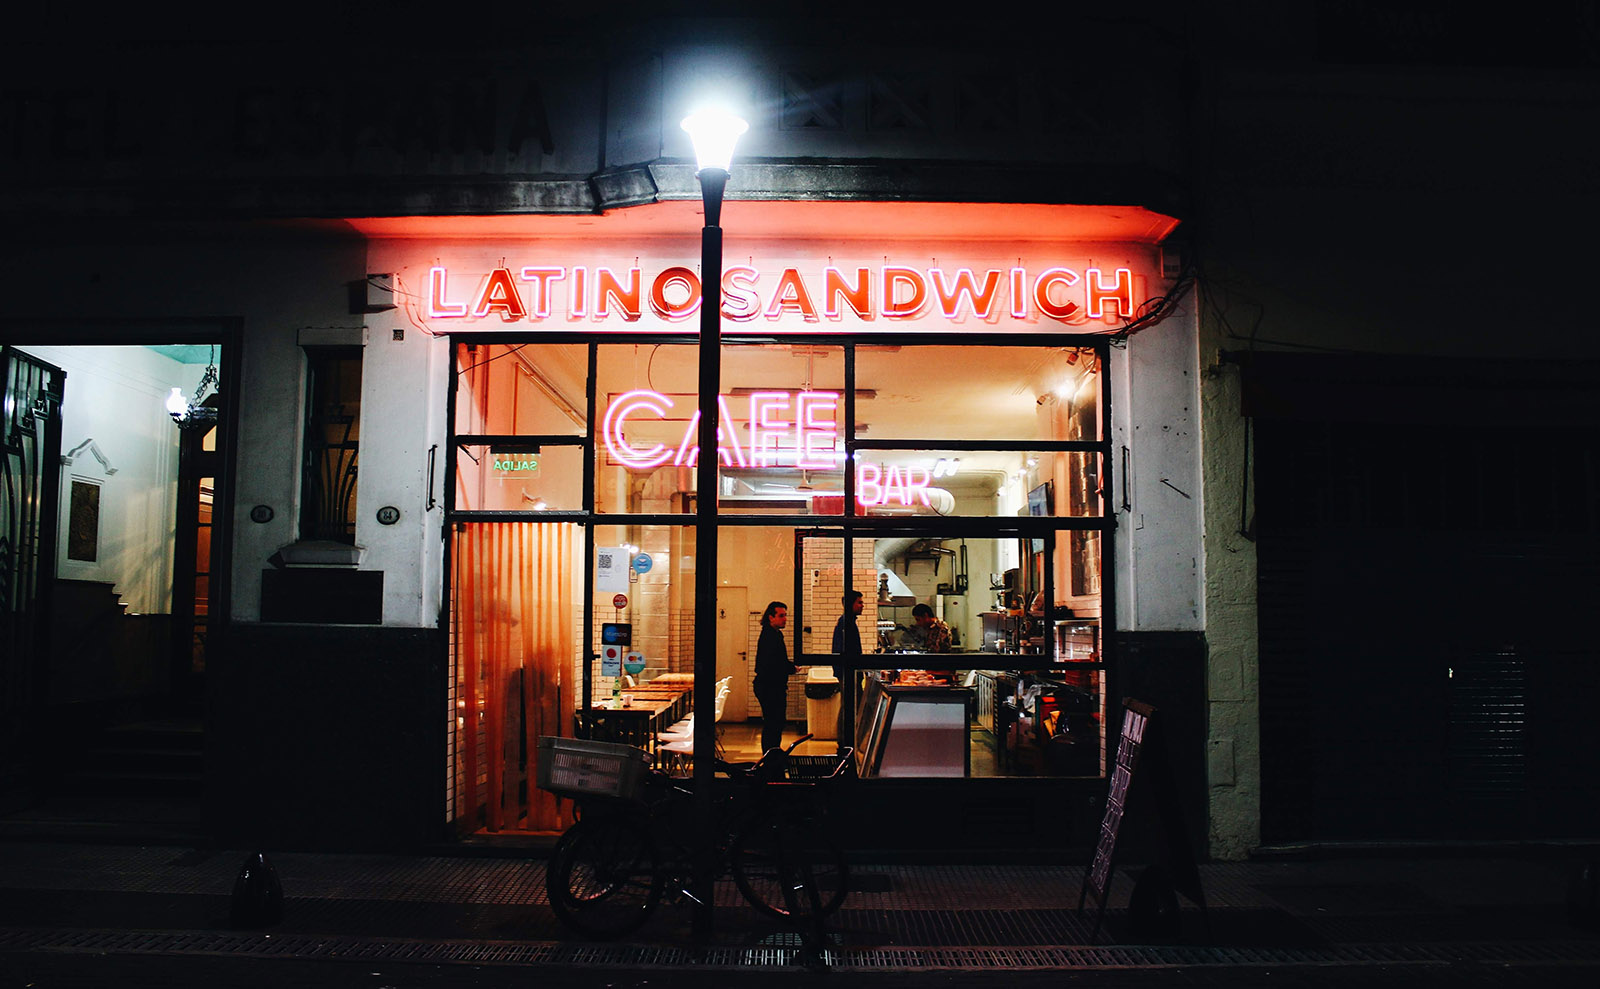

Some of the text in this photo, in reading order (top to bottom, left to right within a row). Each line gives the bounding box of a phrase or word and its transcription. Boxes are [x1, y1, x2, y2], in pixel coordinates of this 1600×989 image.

[428, 265, 1135, 321] LATINO SANDWICH
[602, 388, 840, 470] CAFE
[856, 462, 931, 508] BAR
[383, 510, 392, 520] 84
